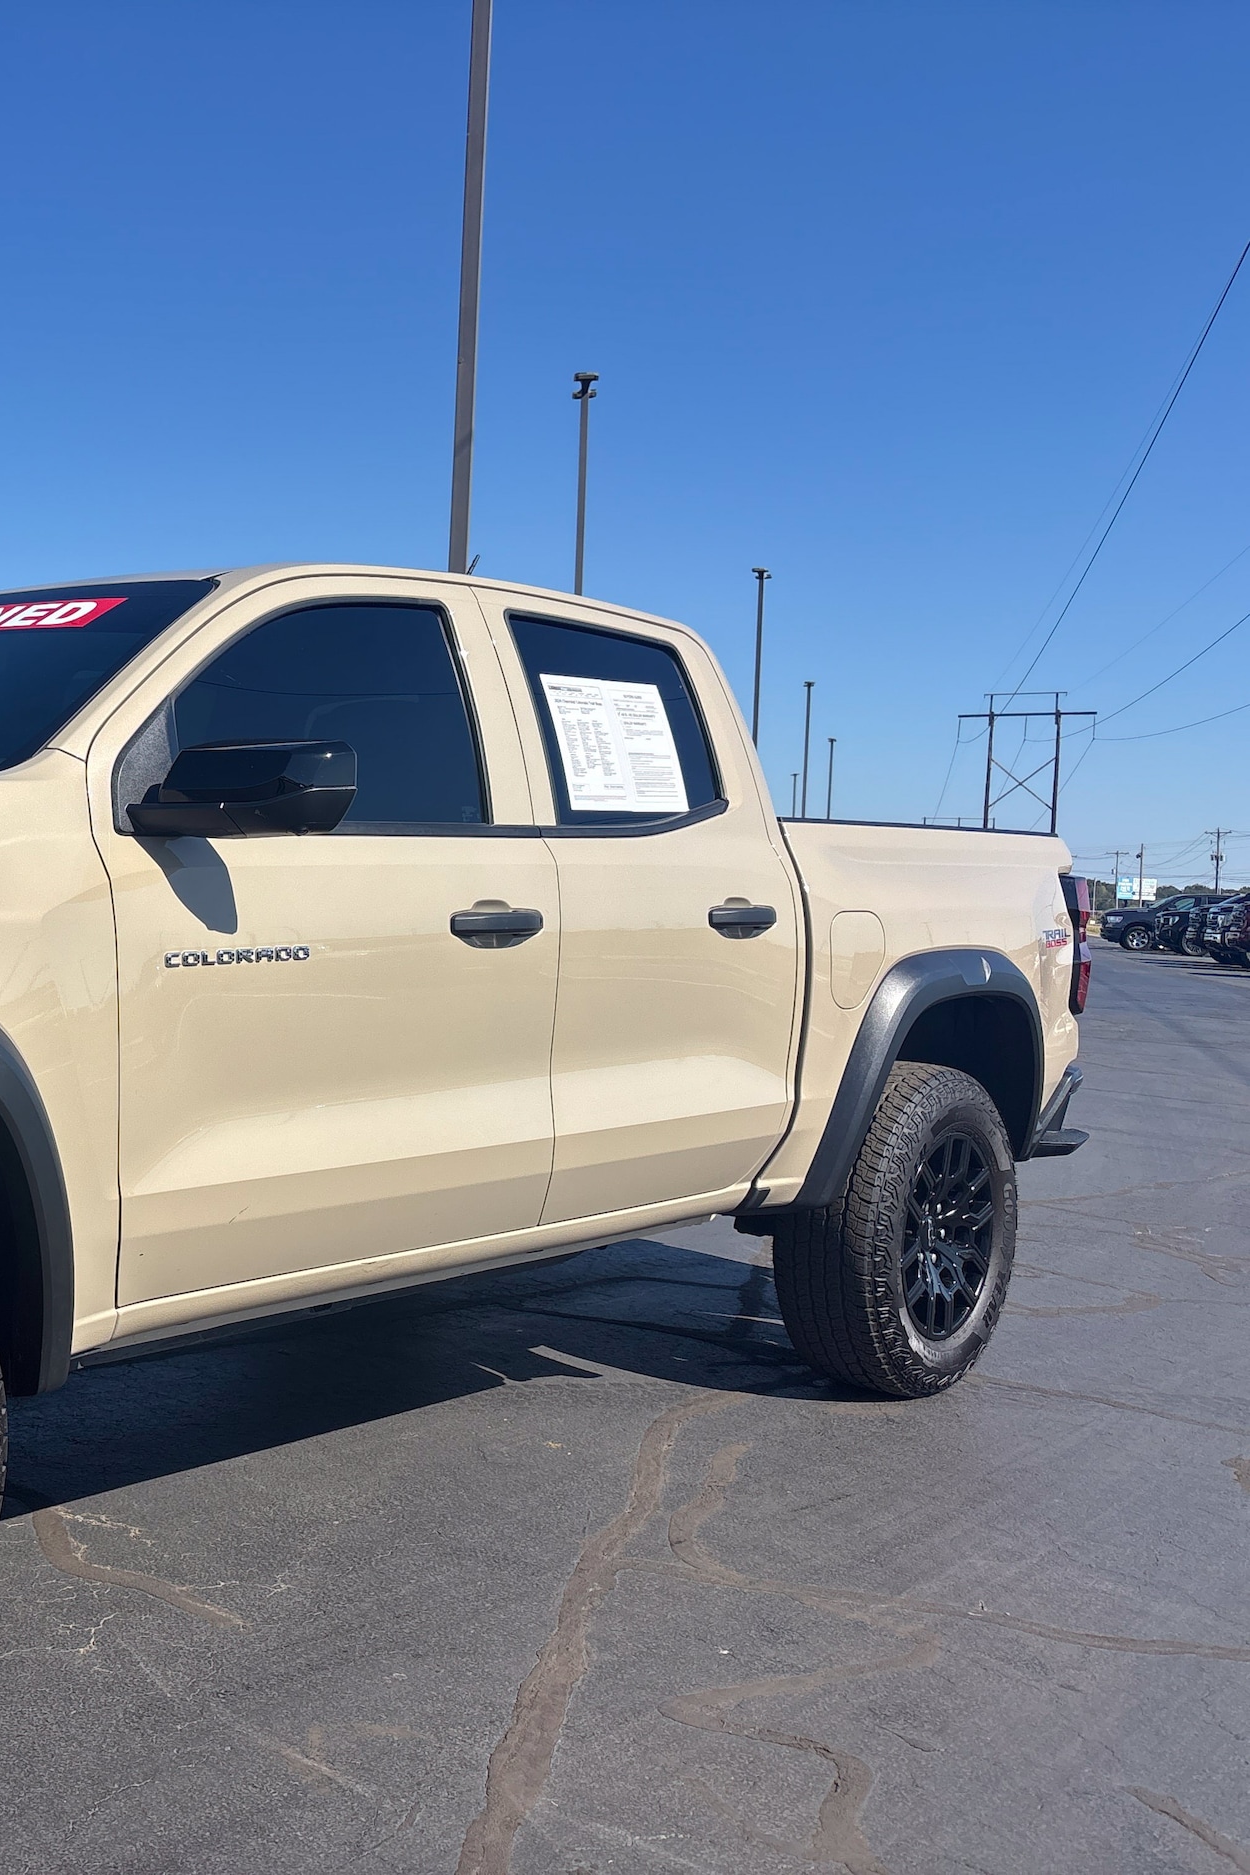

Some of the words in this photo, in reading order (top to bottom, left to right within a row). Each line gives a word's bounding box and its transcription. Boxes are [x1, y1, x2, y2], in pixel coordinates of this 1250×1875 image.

[1042, 928, 1071, 940] TRAIL
[1046, 938, 1068, 949] BOSS
[163, 945, 311, 969] COLORADO
